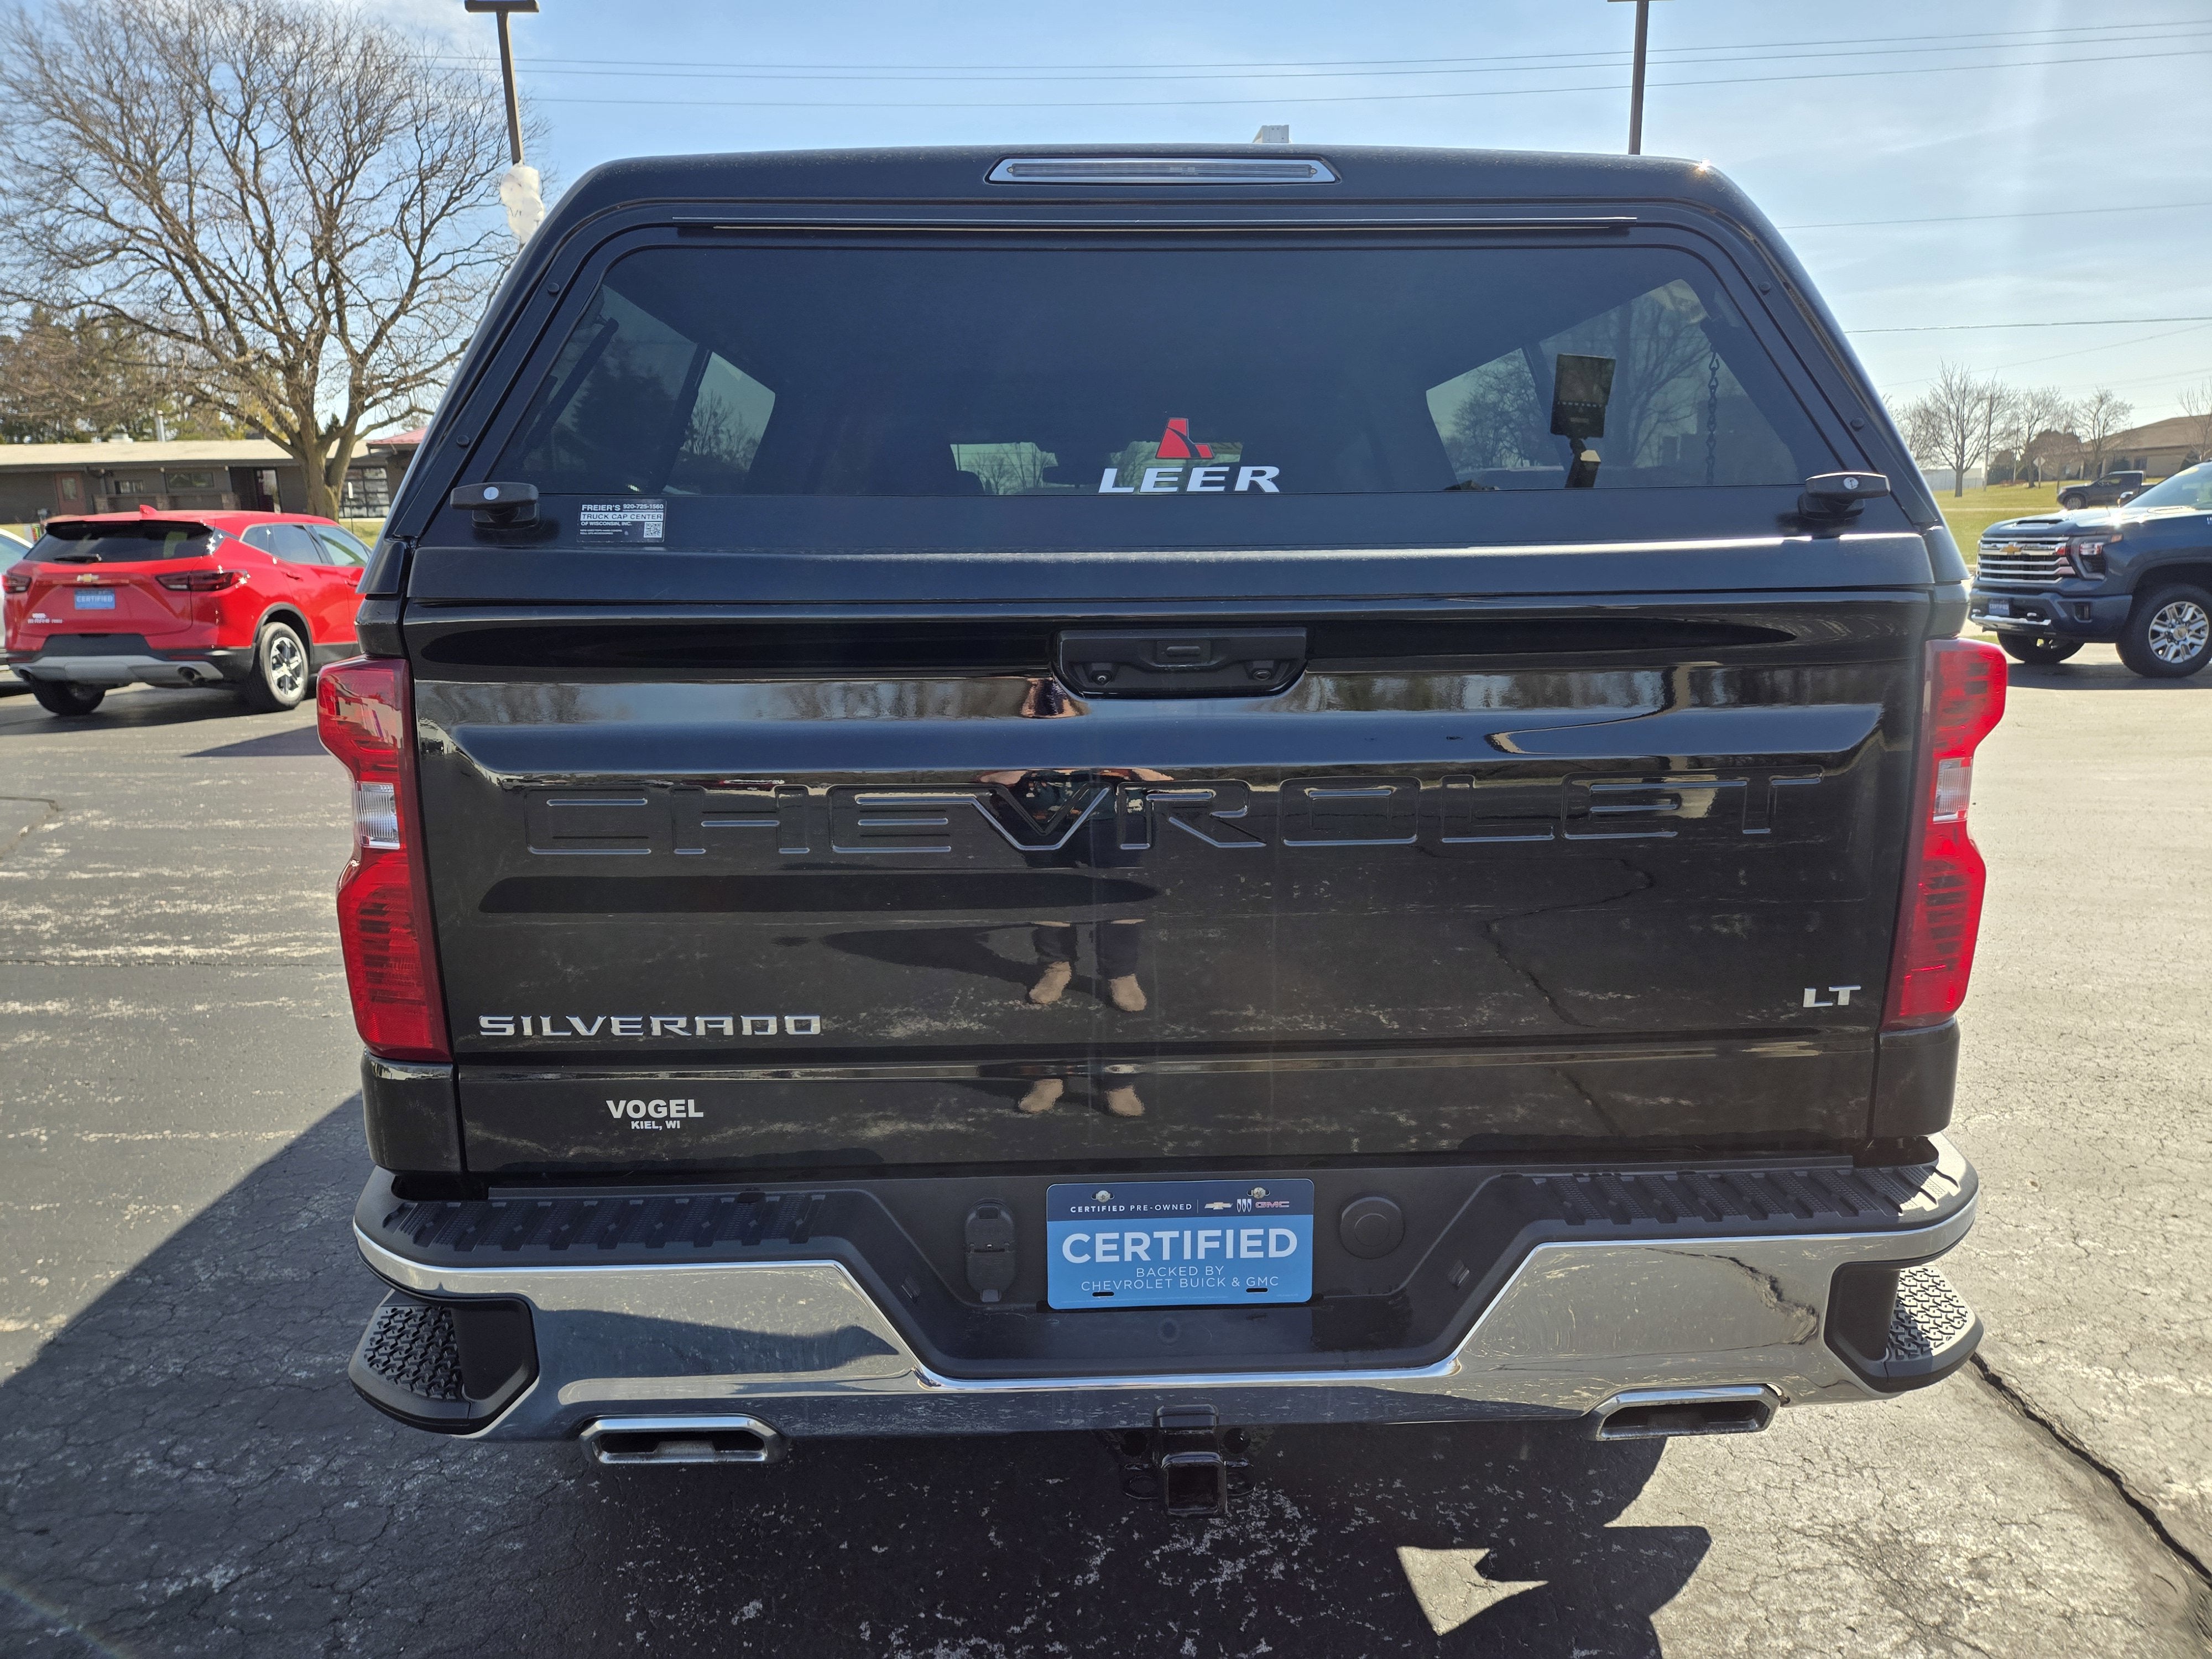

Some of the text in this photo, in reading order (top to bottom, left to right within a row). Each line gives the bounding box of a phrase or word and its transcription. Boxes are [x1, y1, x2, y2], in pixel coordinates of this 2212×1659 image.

[1098, 466, 1280, 493] LEER
[524, 765, 1825, 854] CHEVROLET
[1803, 985, 1861, 1008] LT
[479, 1015, 821, 1037] SILVERADO
[606, 1099, 704, 1119] VOGEL
[631, 1120, 681, 1131] KIEL, WI
[1062, 1228, 1297, 1264] CERTIFIED
[1136, 1266, 1224, 1277] BACKED BY
[1081, 1276, 1279, 1291] CHEVROLET BUICK & GMC
